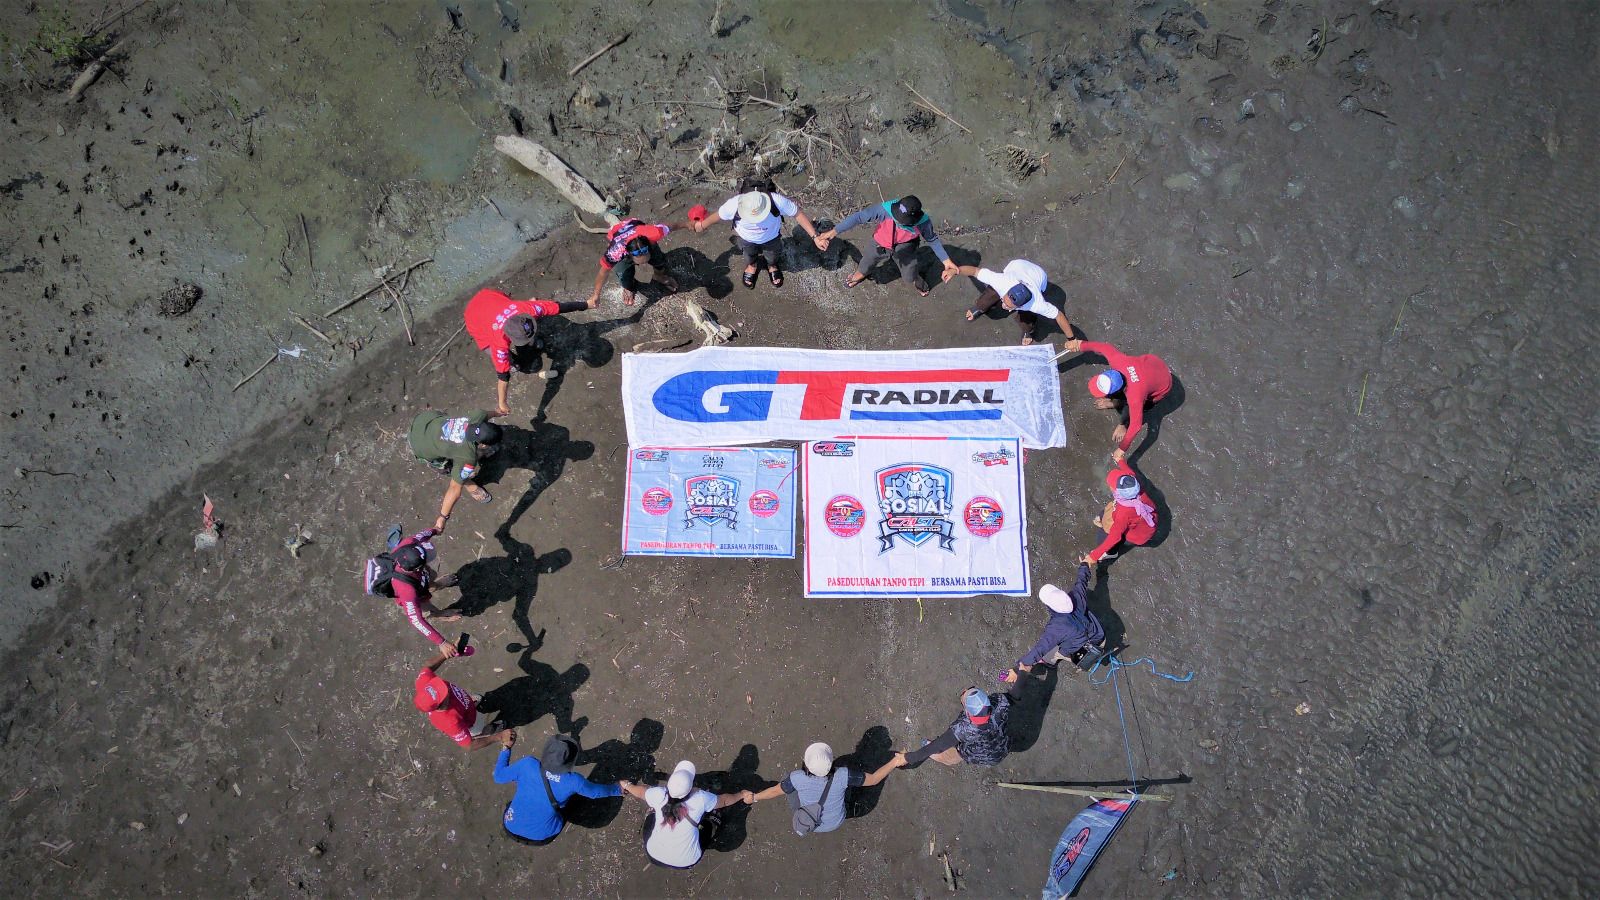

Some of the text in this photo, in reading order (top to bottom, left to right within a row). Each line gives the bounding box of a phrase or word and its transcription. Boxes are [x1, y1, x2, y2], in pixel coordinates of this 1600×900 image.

[652, 369, 1010, 422] GT
[851, 389, 1005, 406] RADIAL
[687, 495, 736, 506] SOSIAL
[881, 498, 950, 514] SOSIAL
[827, 576, 1007, 587] PASEDULURAN TANPO TEPI BERSAMA PASTI BISA
